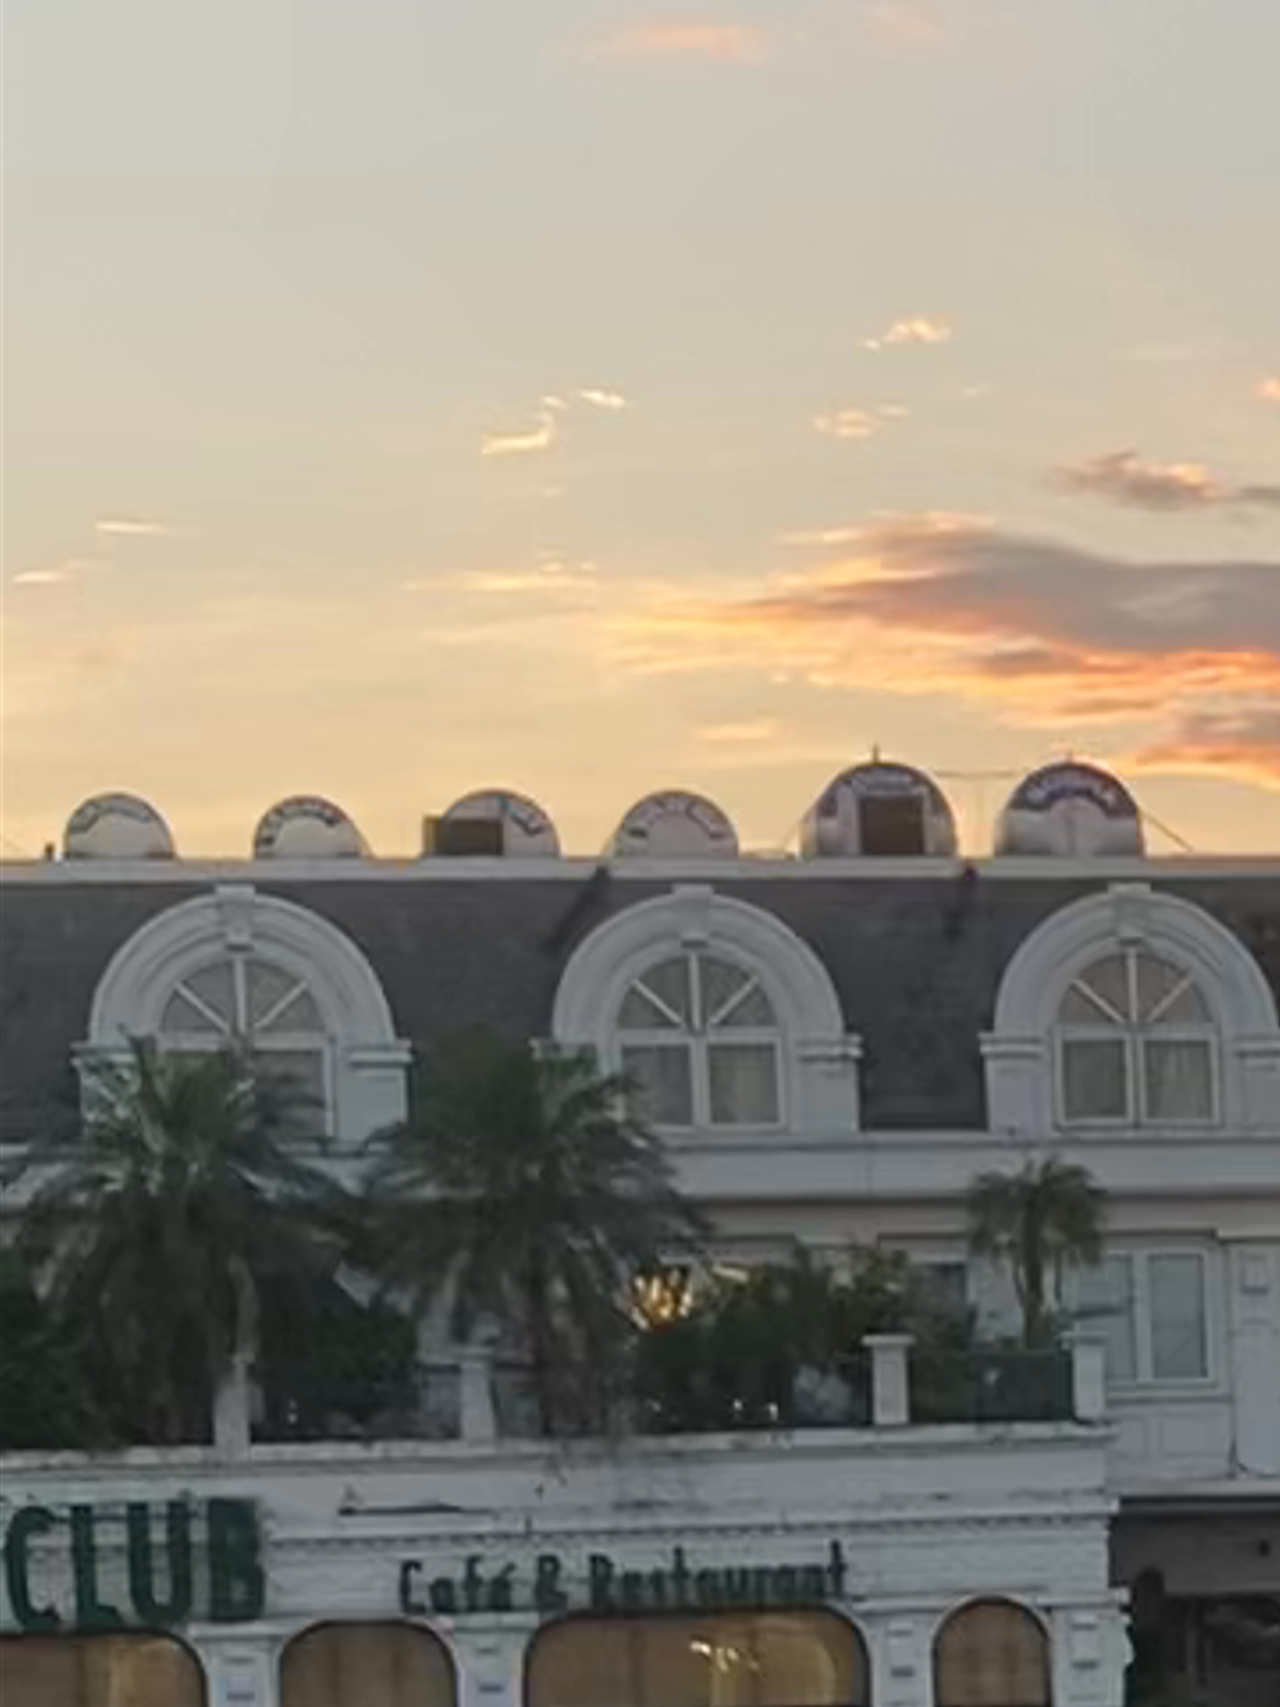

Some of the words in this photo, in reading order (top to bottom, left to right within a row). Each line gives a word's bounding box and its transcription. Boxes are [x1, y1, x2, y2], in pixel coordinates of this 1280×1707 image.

[5, 1497, 266, 1629] CLUB
[399, 1553, 516, 1615] Café
[535, 1553, 569, 1610] &
[588, 1539, 848, 1609] Restaurant
